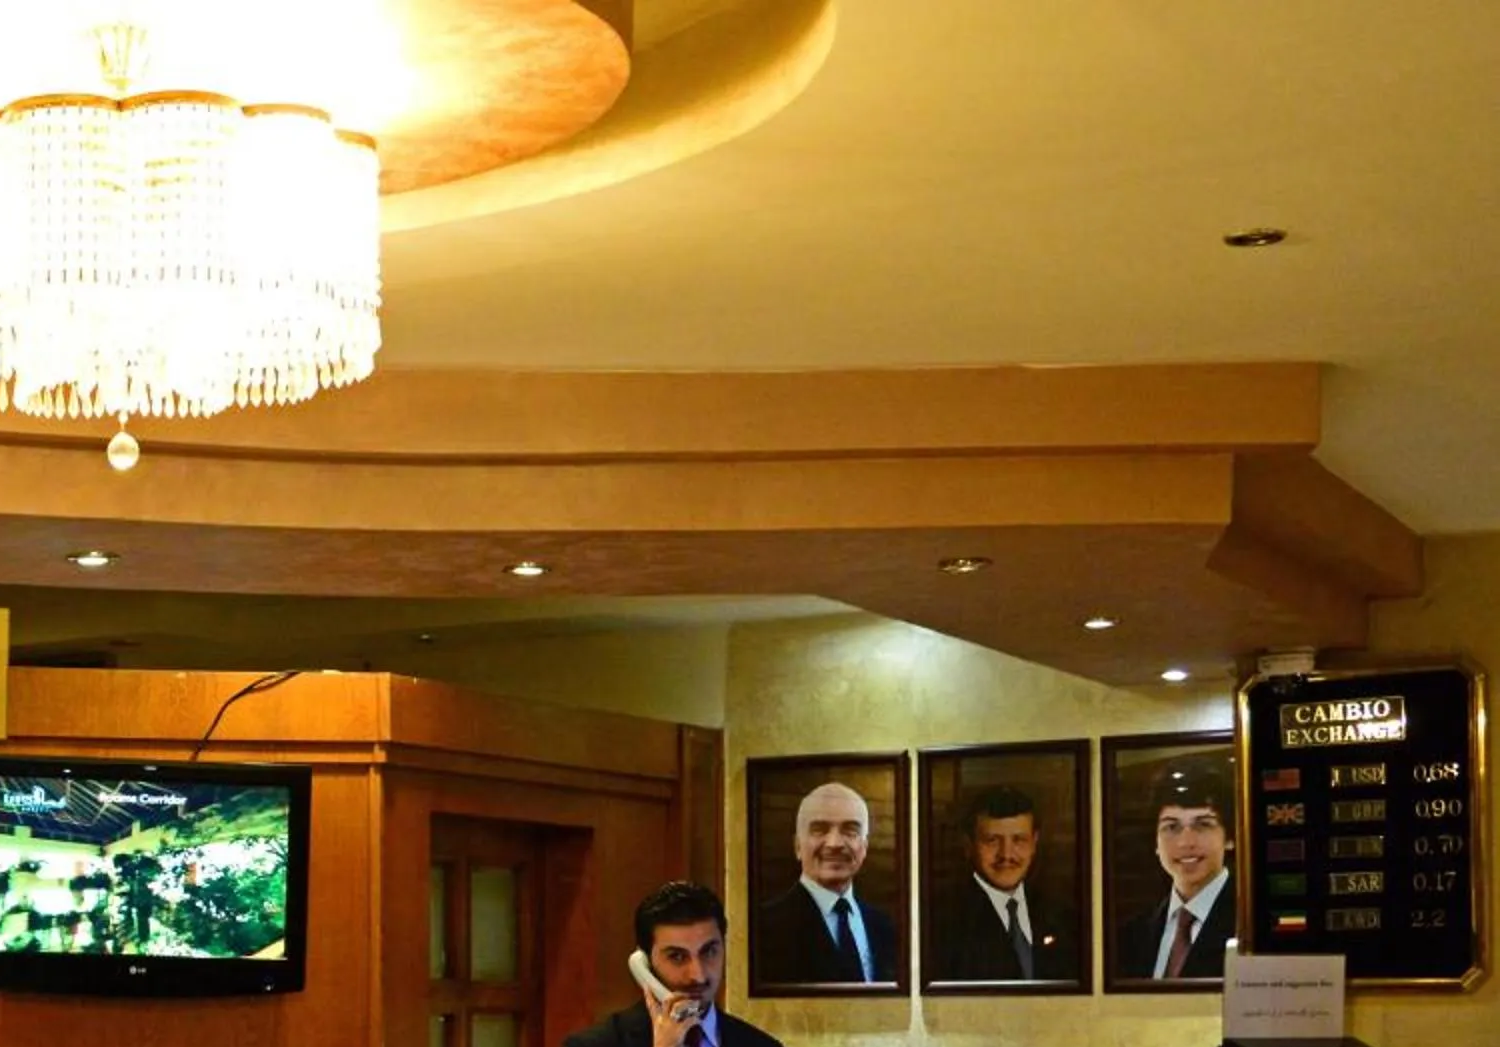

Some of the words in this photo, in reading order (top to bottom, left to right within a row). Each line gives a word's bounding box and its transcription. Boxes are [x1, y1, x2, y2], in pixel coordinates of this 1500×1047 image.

[1294, 699, 1391, 724] CAMBIO
[1286, 720, 1402, 745] EXCHANGE
[1351, 765, 1383, 784] USD
[140, 794, 188, 806] Corridor
[1347, 873, 1380, 892] SAR
